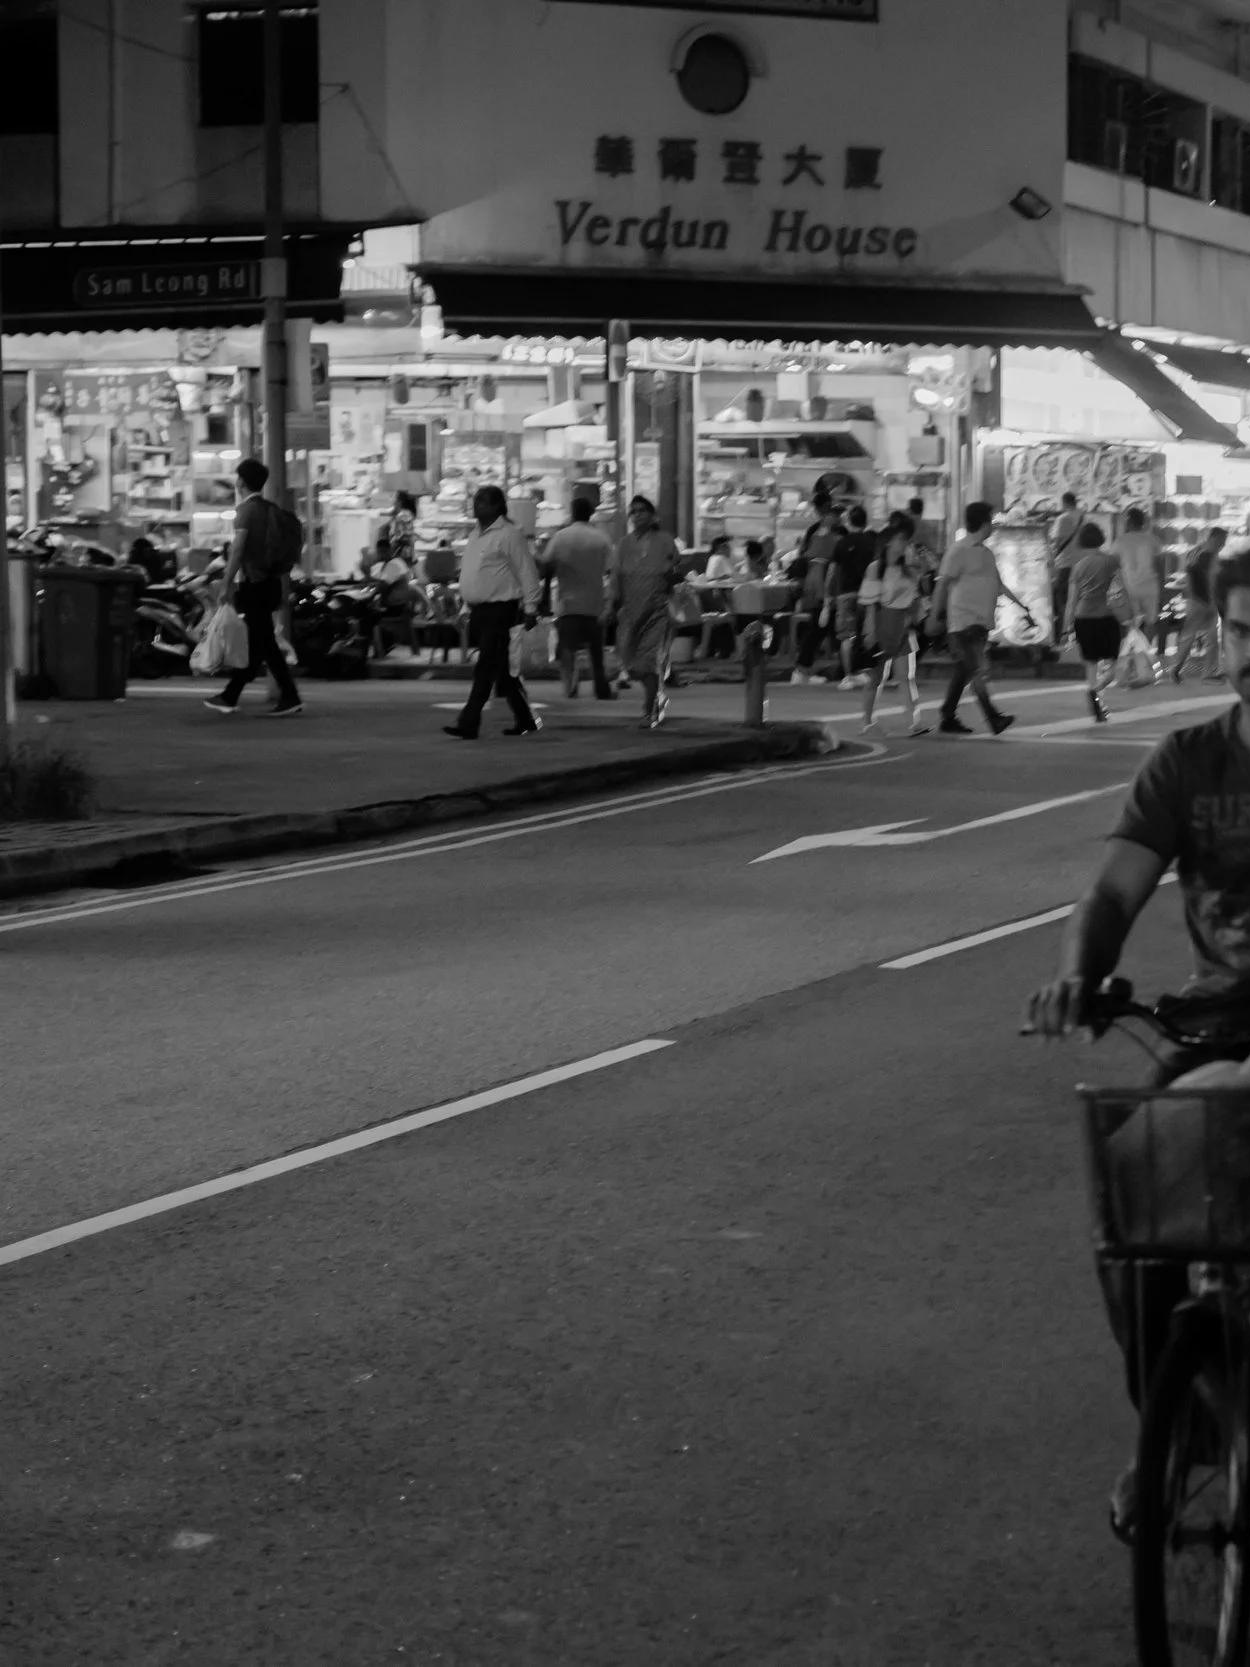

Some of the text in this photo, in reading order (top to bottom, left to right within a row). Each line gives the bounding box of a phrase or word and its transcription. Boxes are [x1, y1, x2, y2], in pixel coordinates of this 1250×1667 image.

[554, 199, 919, 259] Verdun House
[86, 272, 133, 297] Sam
[218, 265, 247, 291] Rd
